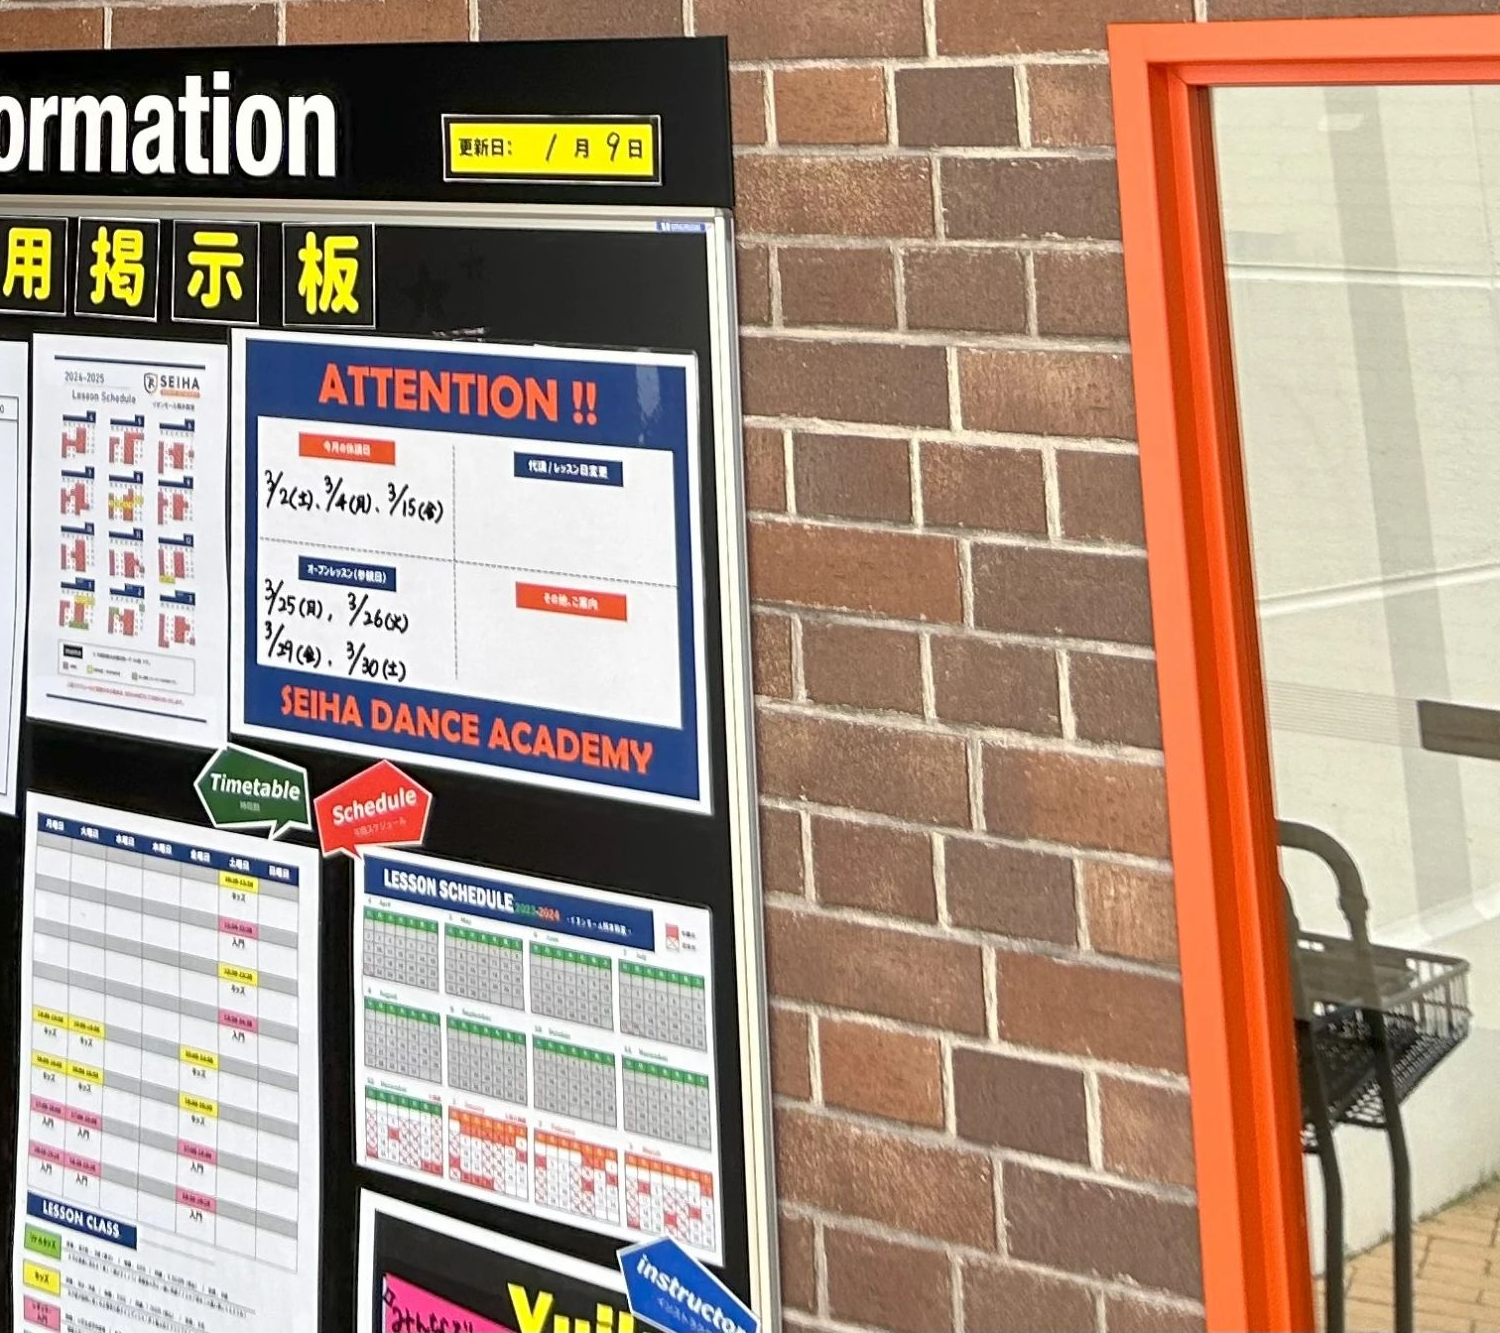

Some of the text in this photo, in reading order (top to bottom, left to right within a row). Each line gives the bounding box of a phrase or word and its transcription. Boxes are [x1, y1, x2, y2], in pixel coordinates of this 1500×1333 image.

[160, 375, 201, 390] SEIHA
[317, 362, 598, 426] ATTENTION !!
[281, 684, 654, 776] SEIHA DANCE ACADEMY
[210, 772, 301, 801] Timetable
[331, 786, 418, 826] Schedule
[384, 867, 437, 897] LESSON
[438, 879, 515, 913] SCHEDULE
[42, 1200, 121, 1239] LESSON CLASS
